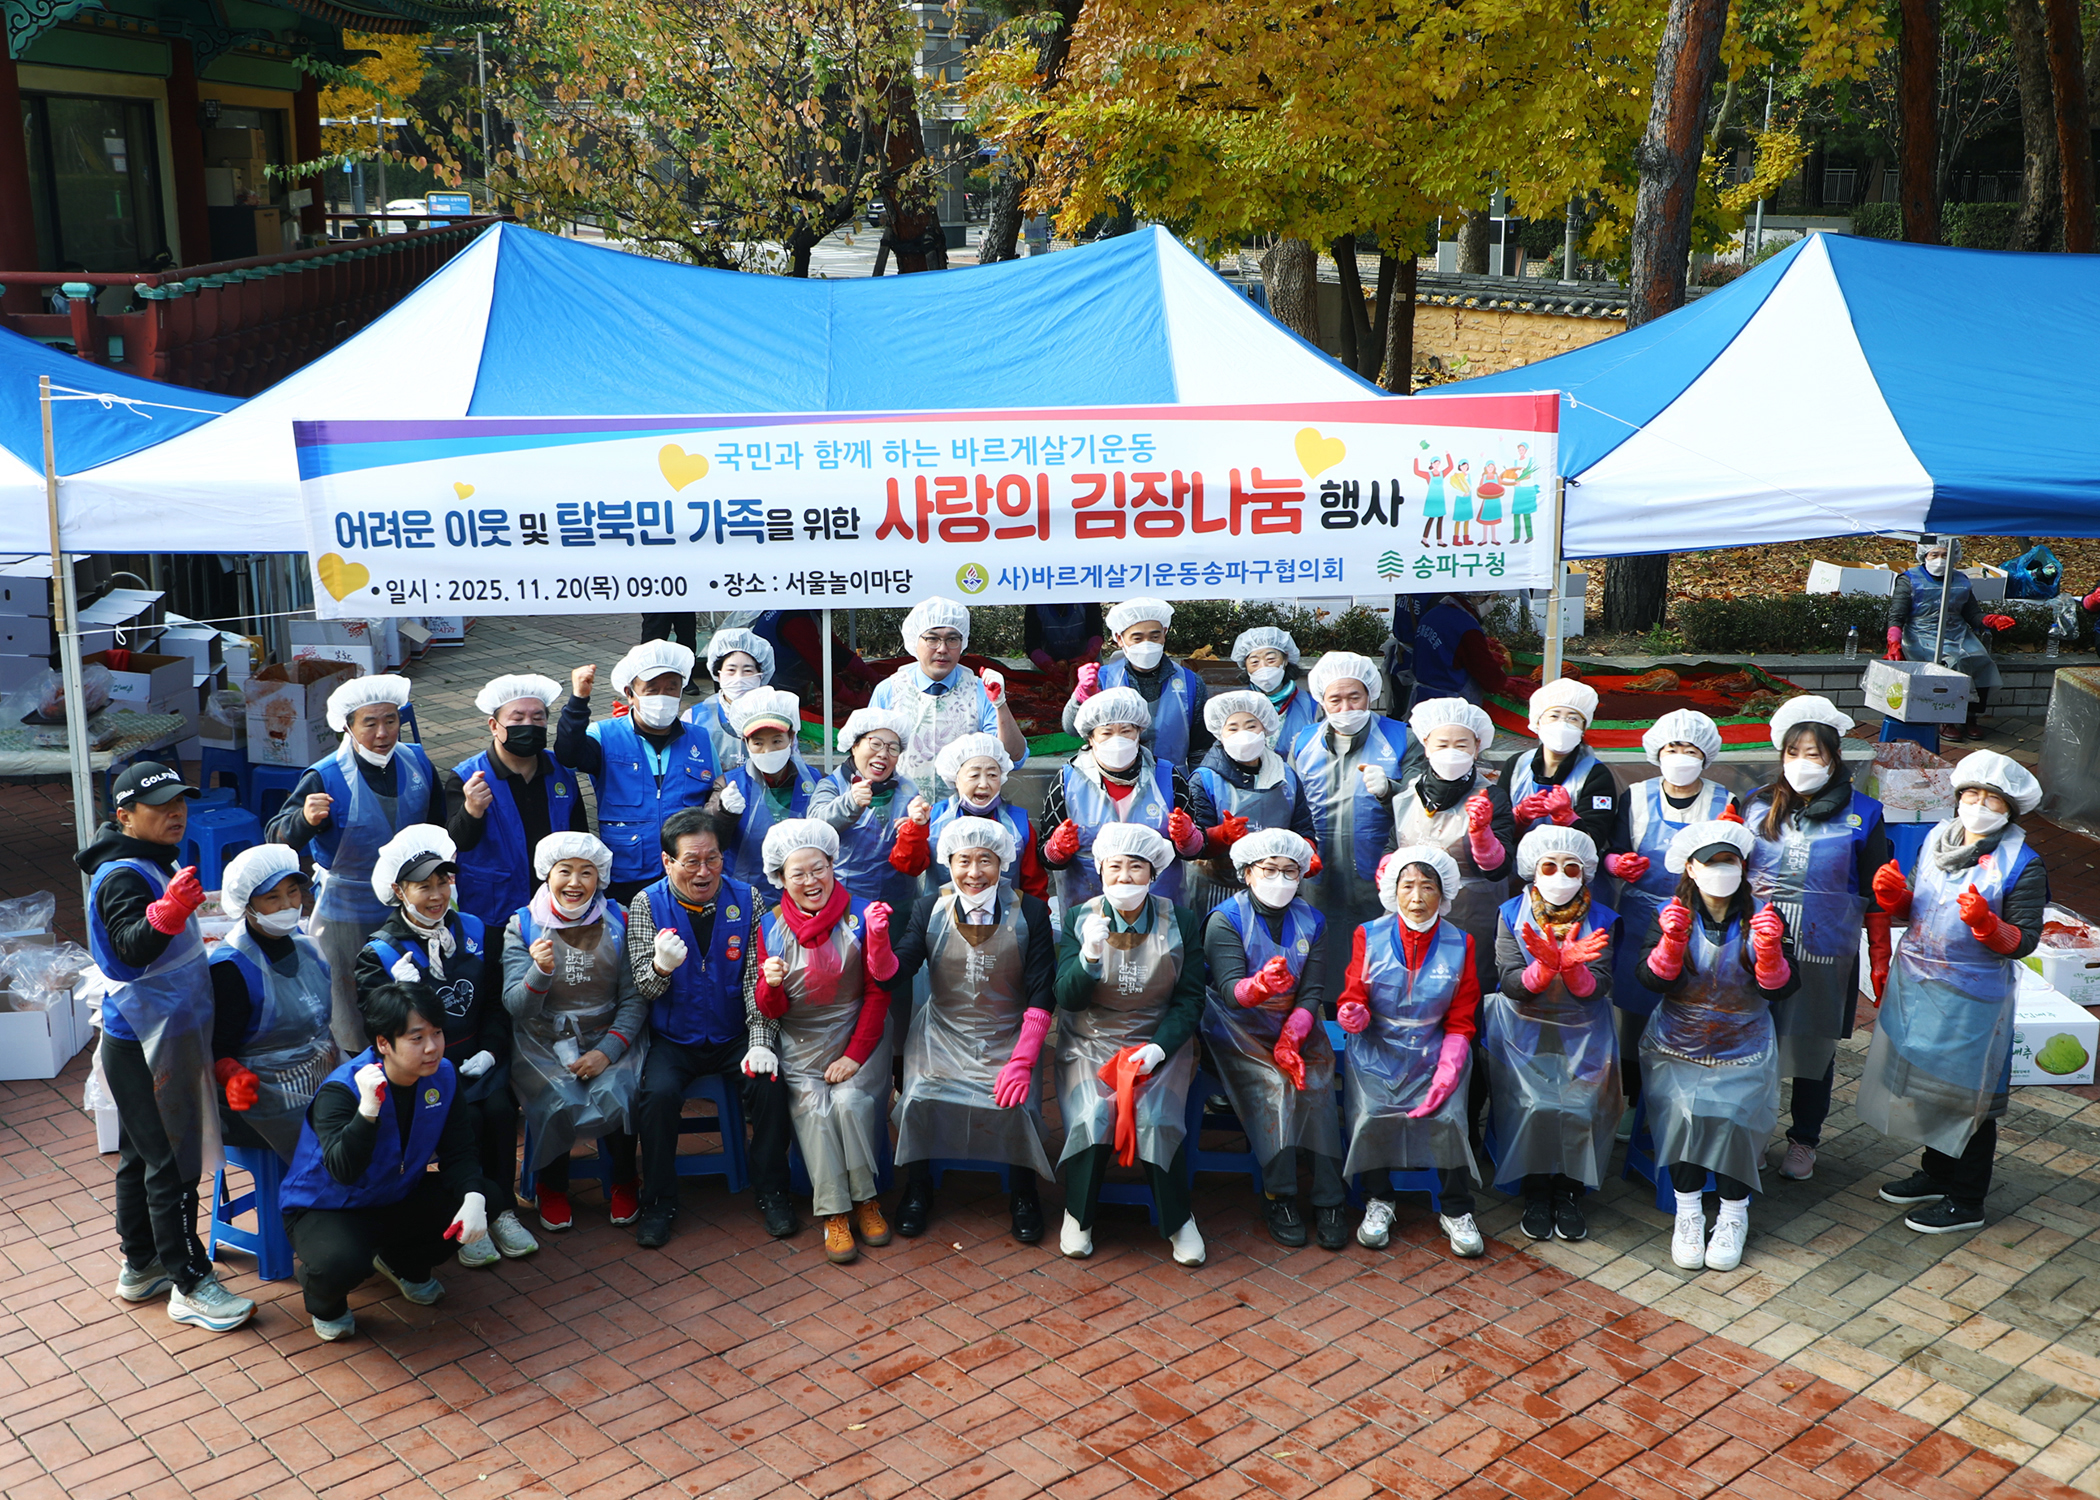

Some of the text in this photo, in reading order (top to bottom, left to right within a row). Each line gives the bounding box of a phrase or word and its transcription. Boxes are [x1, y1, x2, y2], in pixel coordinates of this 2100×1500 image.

[715, 433, 1157, 471] 국민과 함께 하는 바르게살기운동
[335, 466, 1404, 549] 어려운 이웃 및 탈북민 가족을 위한 사랑의 김장나눔 행사
[998, 558, 1344, 592] 사)바르게살기운동송파구협의회
[1413, 551, 1505, 579] 송파구청
[448, 580, 509, 602] 2025.
[517, 579, 550, 601] 11.
[556, 576, 619, 601] 20(목)
[627, 576, 687, 598] 09:00
[785, 569, 913, 596] 서울놀이마당
[185, 1297, 209, 1314] HOKA
